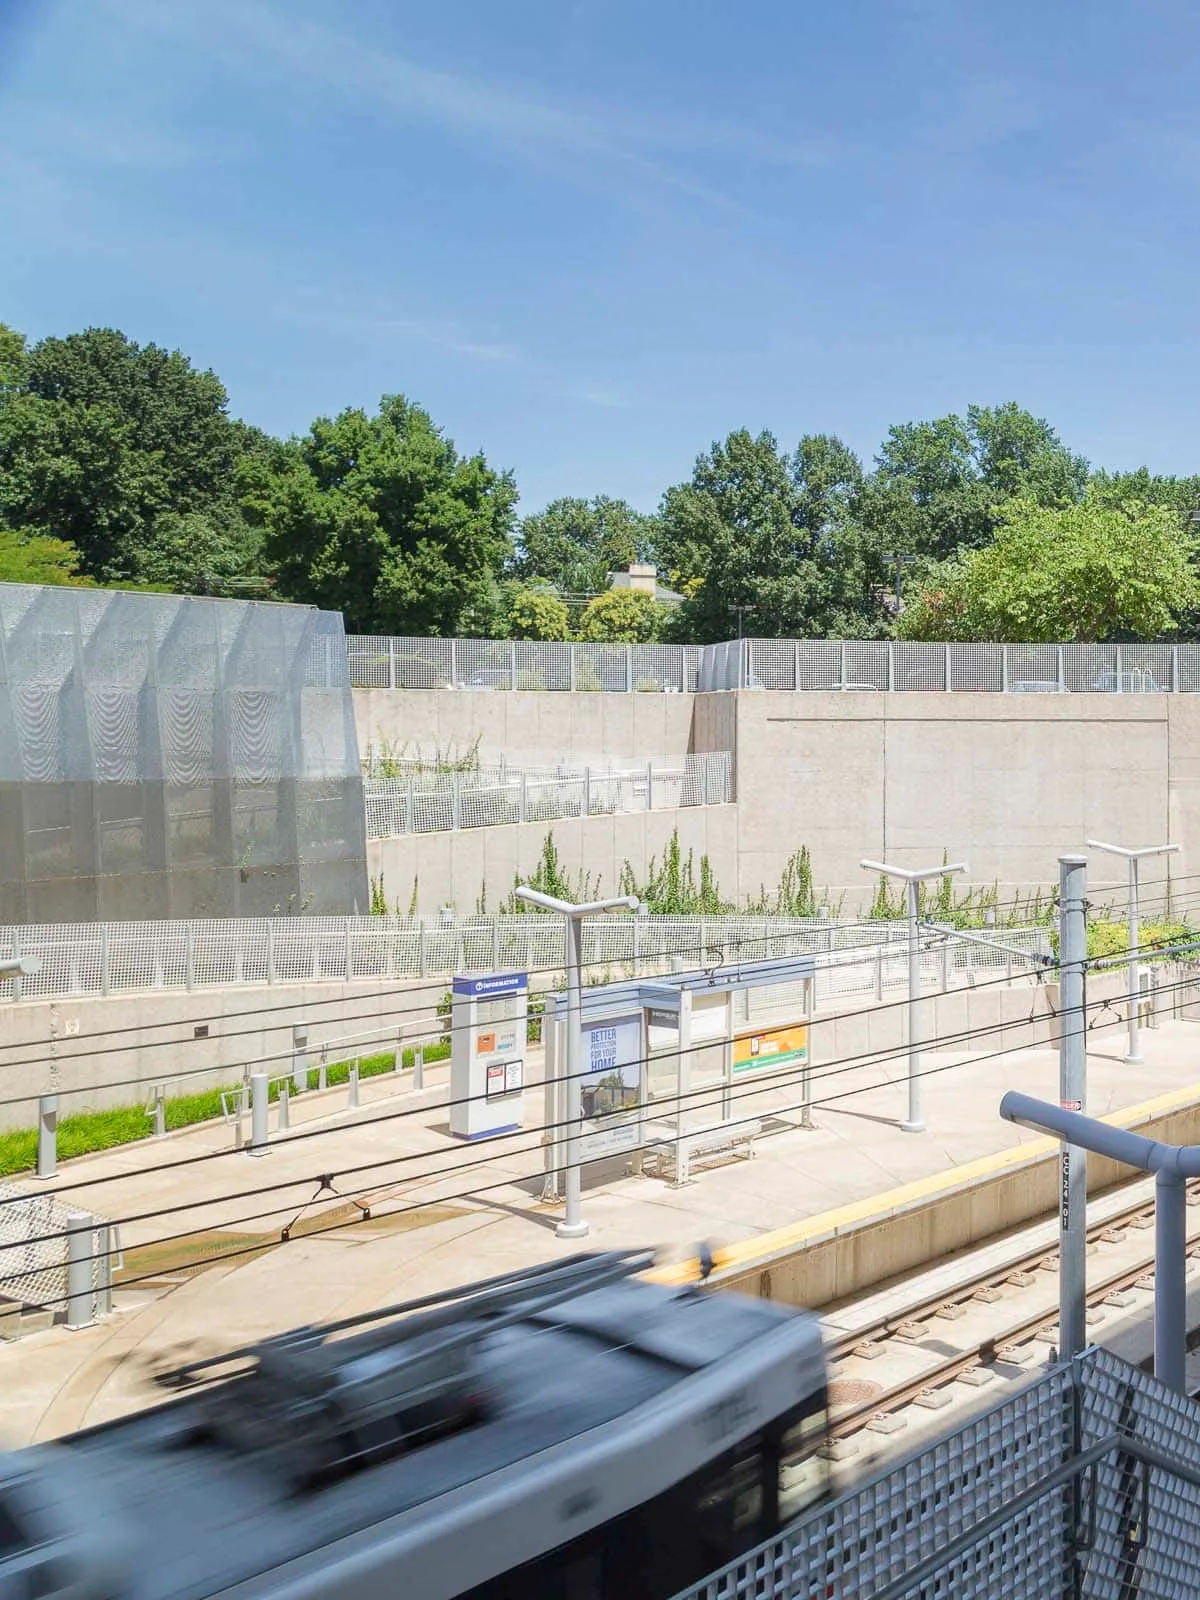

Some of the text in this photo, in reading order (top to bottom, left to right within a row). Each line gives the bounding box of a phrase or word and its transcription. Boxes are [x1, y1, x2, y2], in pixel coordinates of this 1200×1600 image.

[591, 1028, 617, 1043] BETTER
[602, 1047, 617, 1058] YOUR
[591, 1056, 617, 1073] HOME
